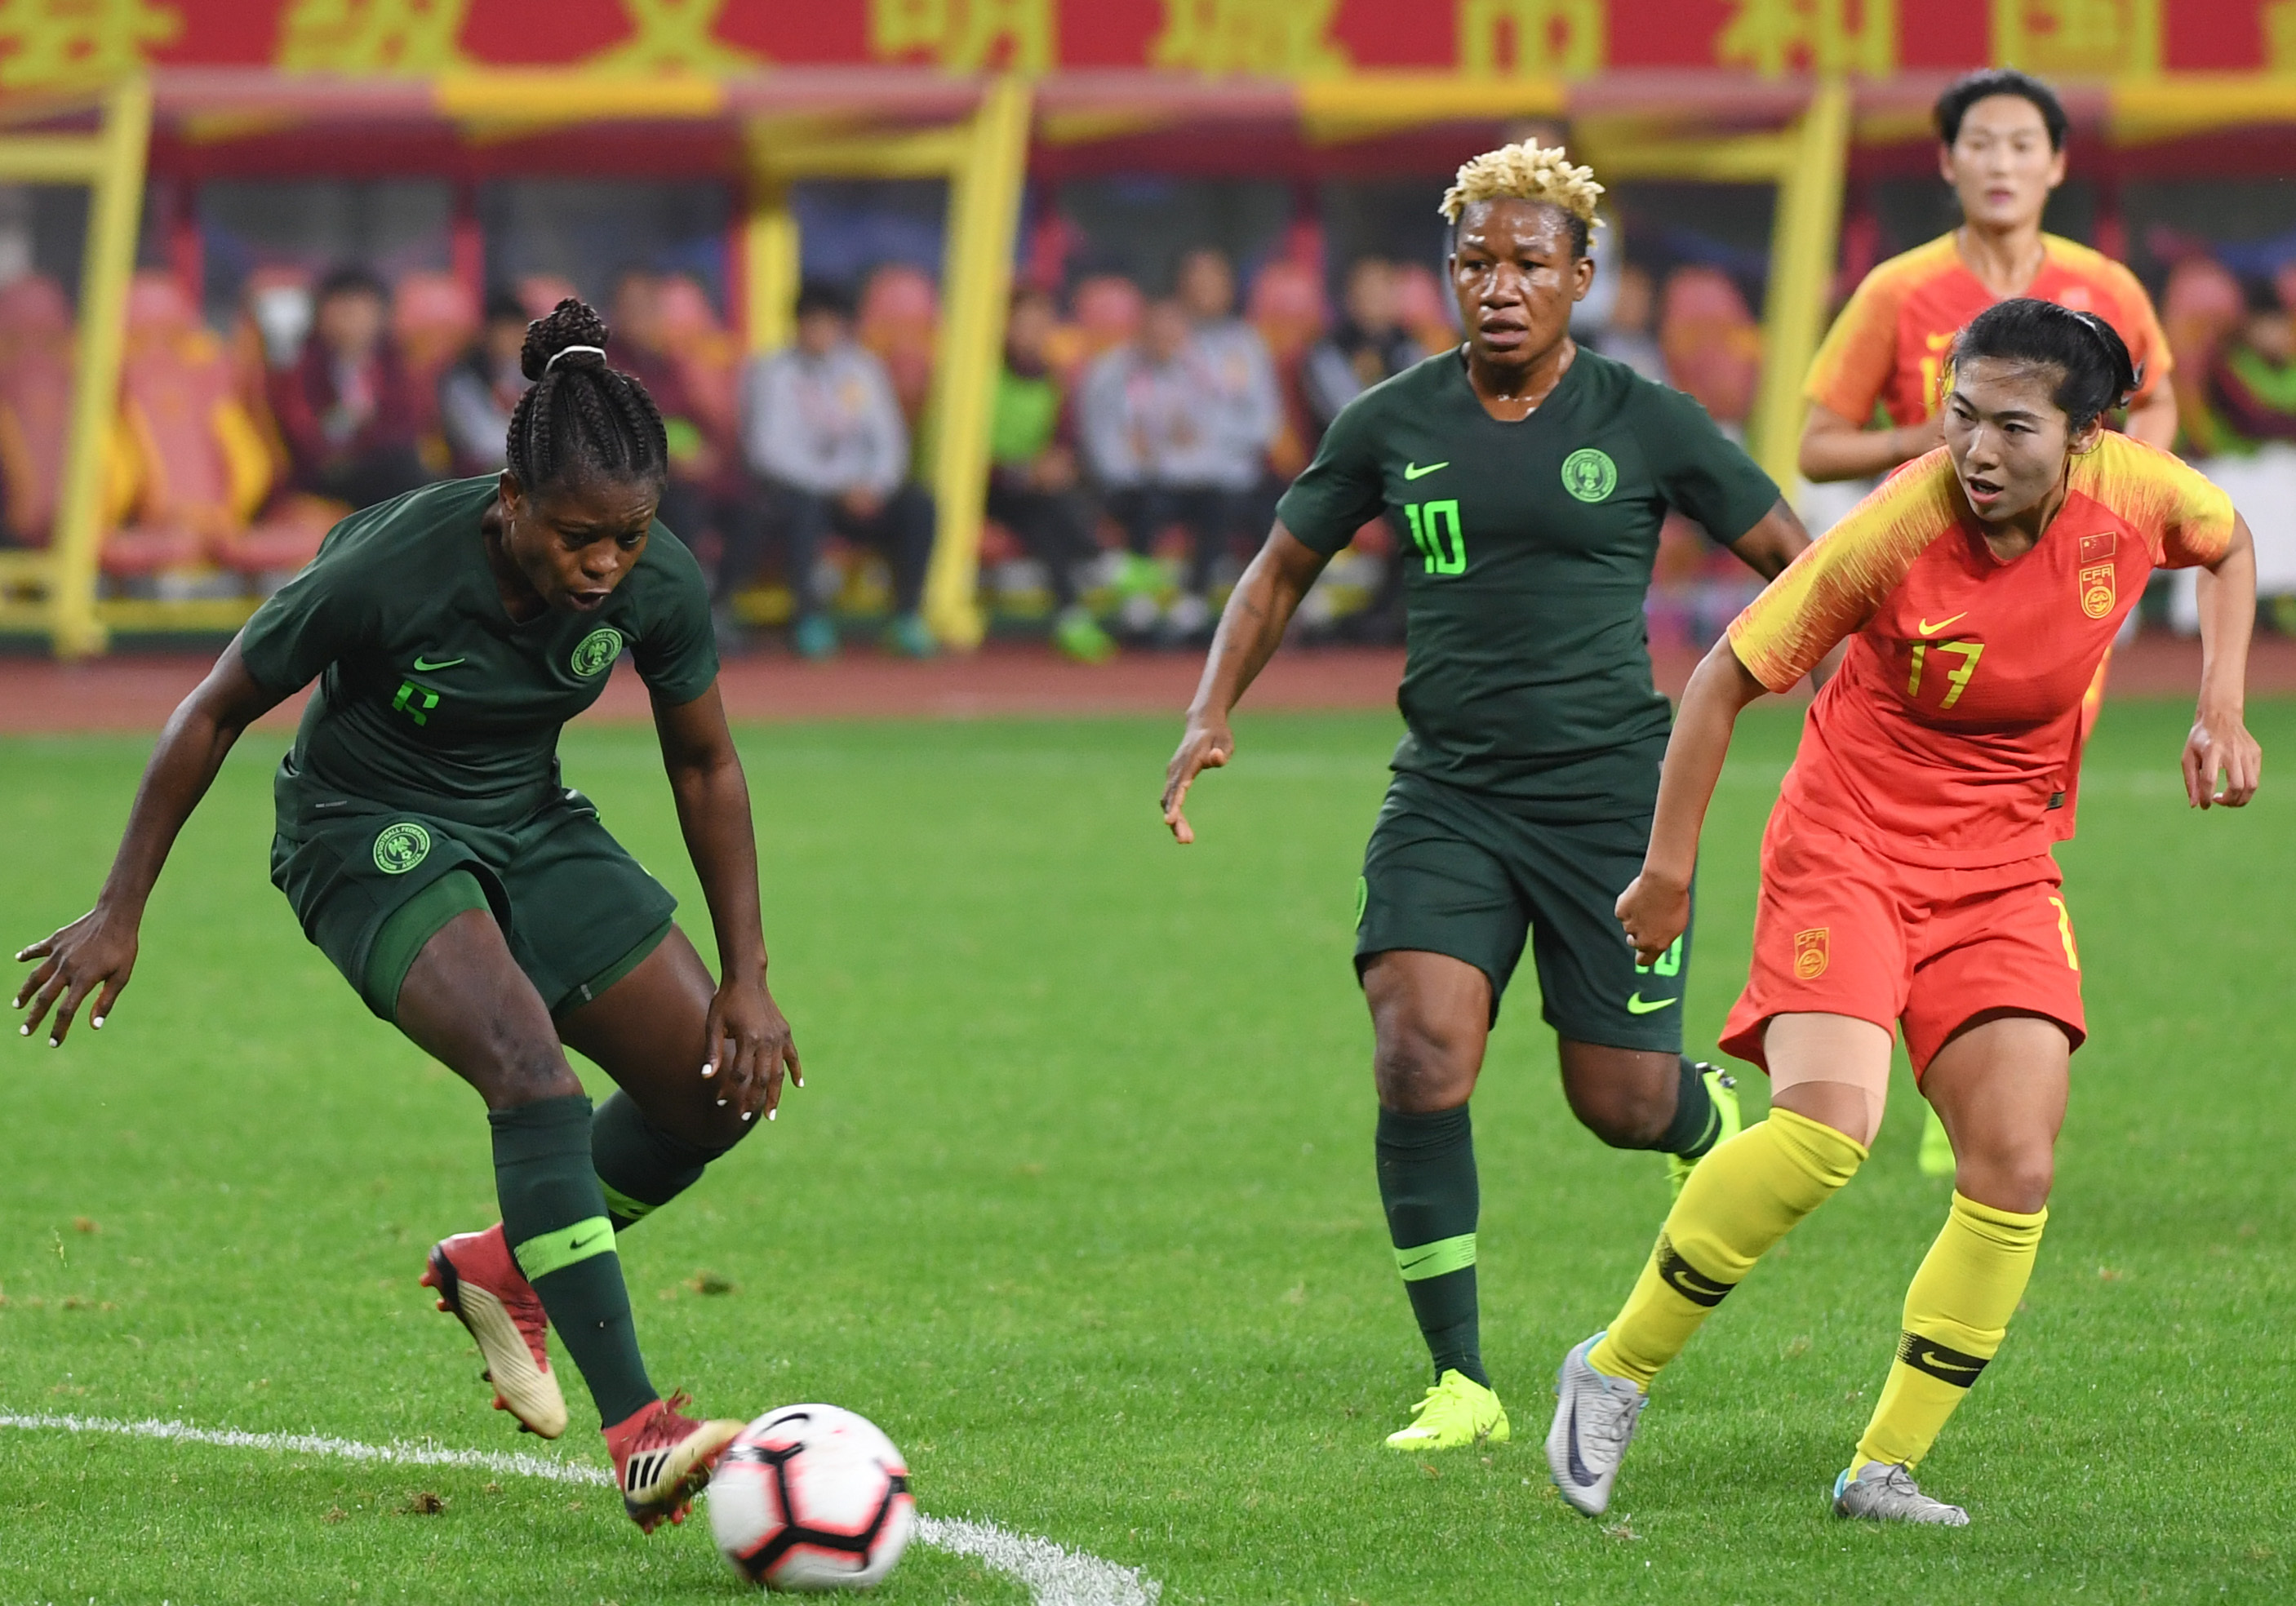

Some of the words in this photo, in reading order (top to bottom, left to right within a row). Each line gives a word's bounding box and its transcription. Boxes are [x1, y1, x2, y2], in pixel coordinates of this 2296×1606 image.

[1405, 499, 1467, 575] 10
[2082, 567, 2112, 582] CFA
[1907, 640, 1985, 710] 17
[1796, 931, 1826, 946] CFA
